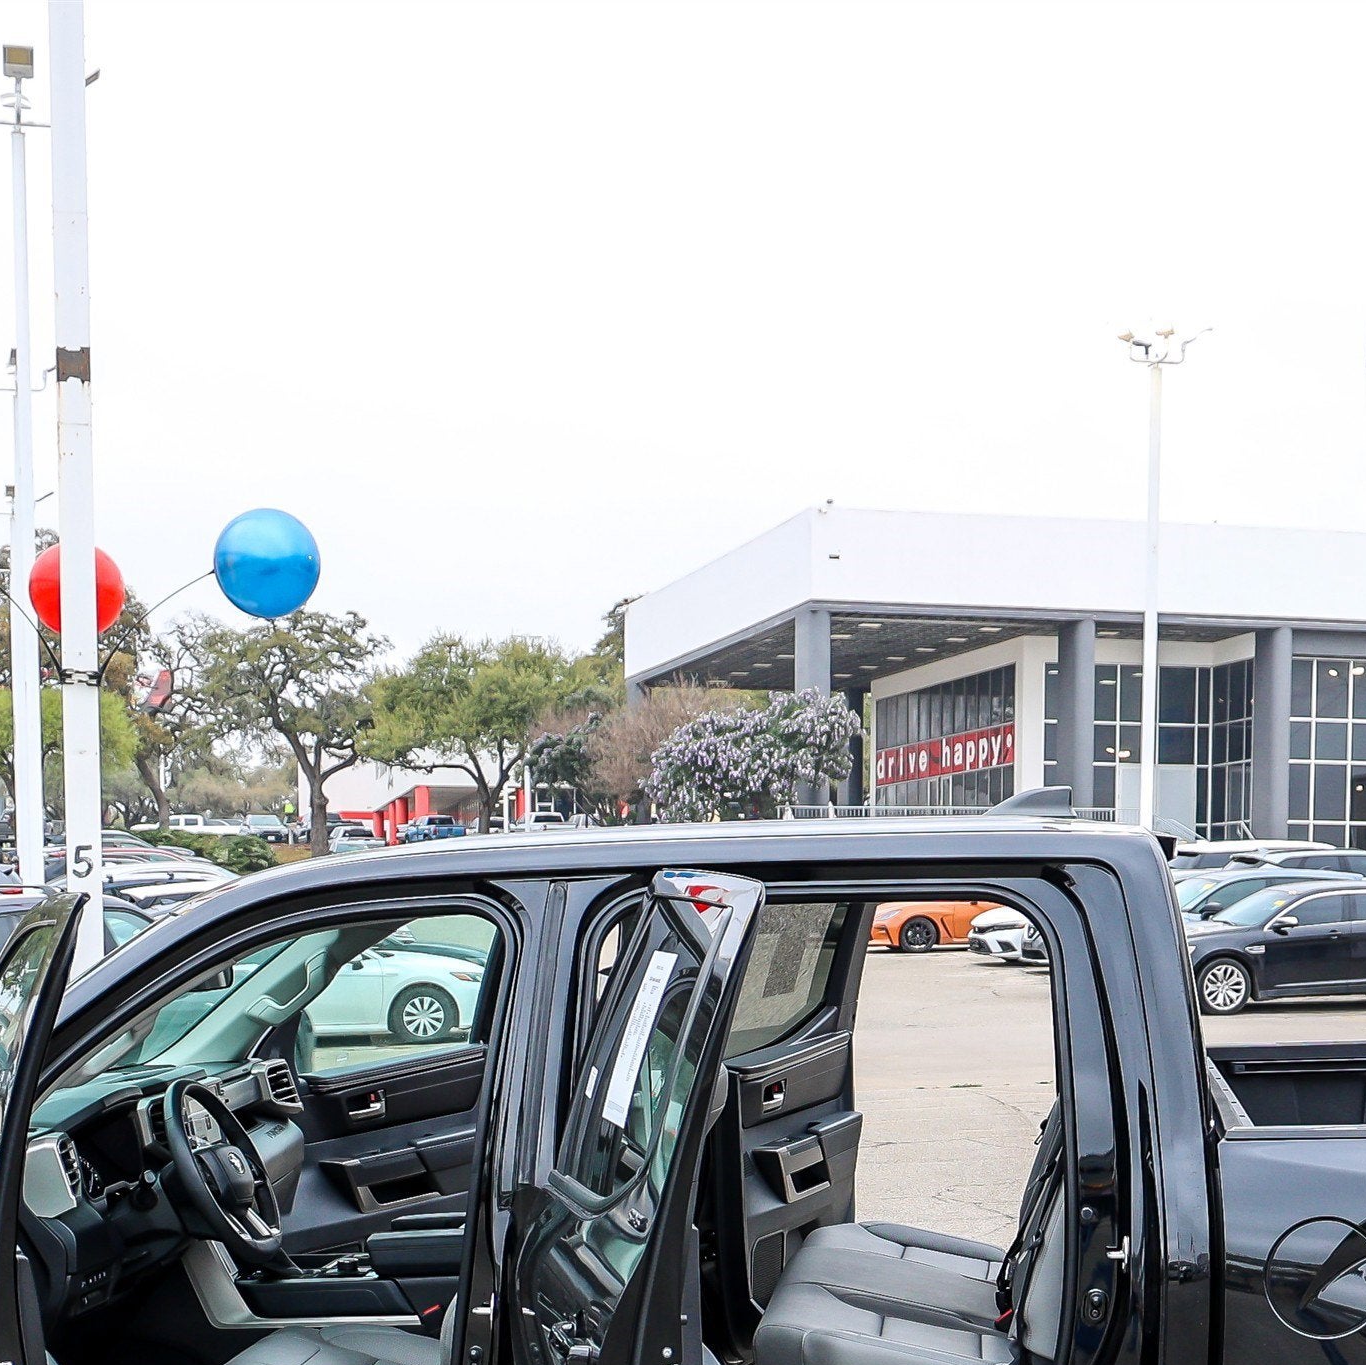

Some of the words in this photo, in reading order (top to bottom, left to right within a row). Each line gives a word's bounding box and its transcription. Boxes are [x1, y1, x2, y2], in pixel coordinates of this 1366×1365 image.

[876, 748, 927, 779] drive
[942, 734, 1002, 771] happy
[73, 845, 93, 878] 5
